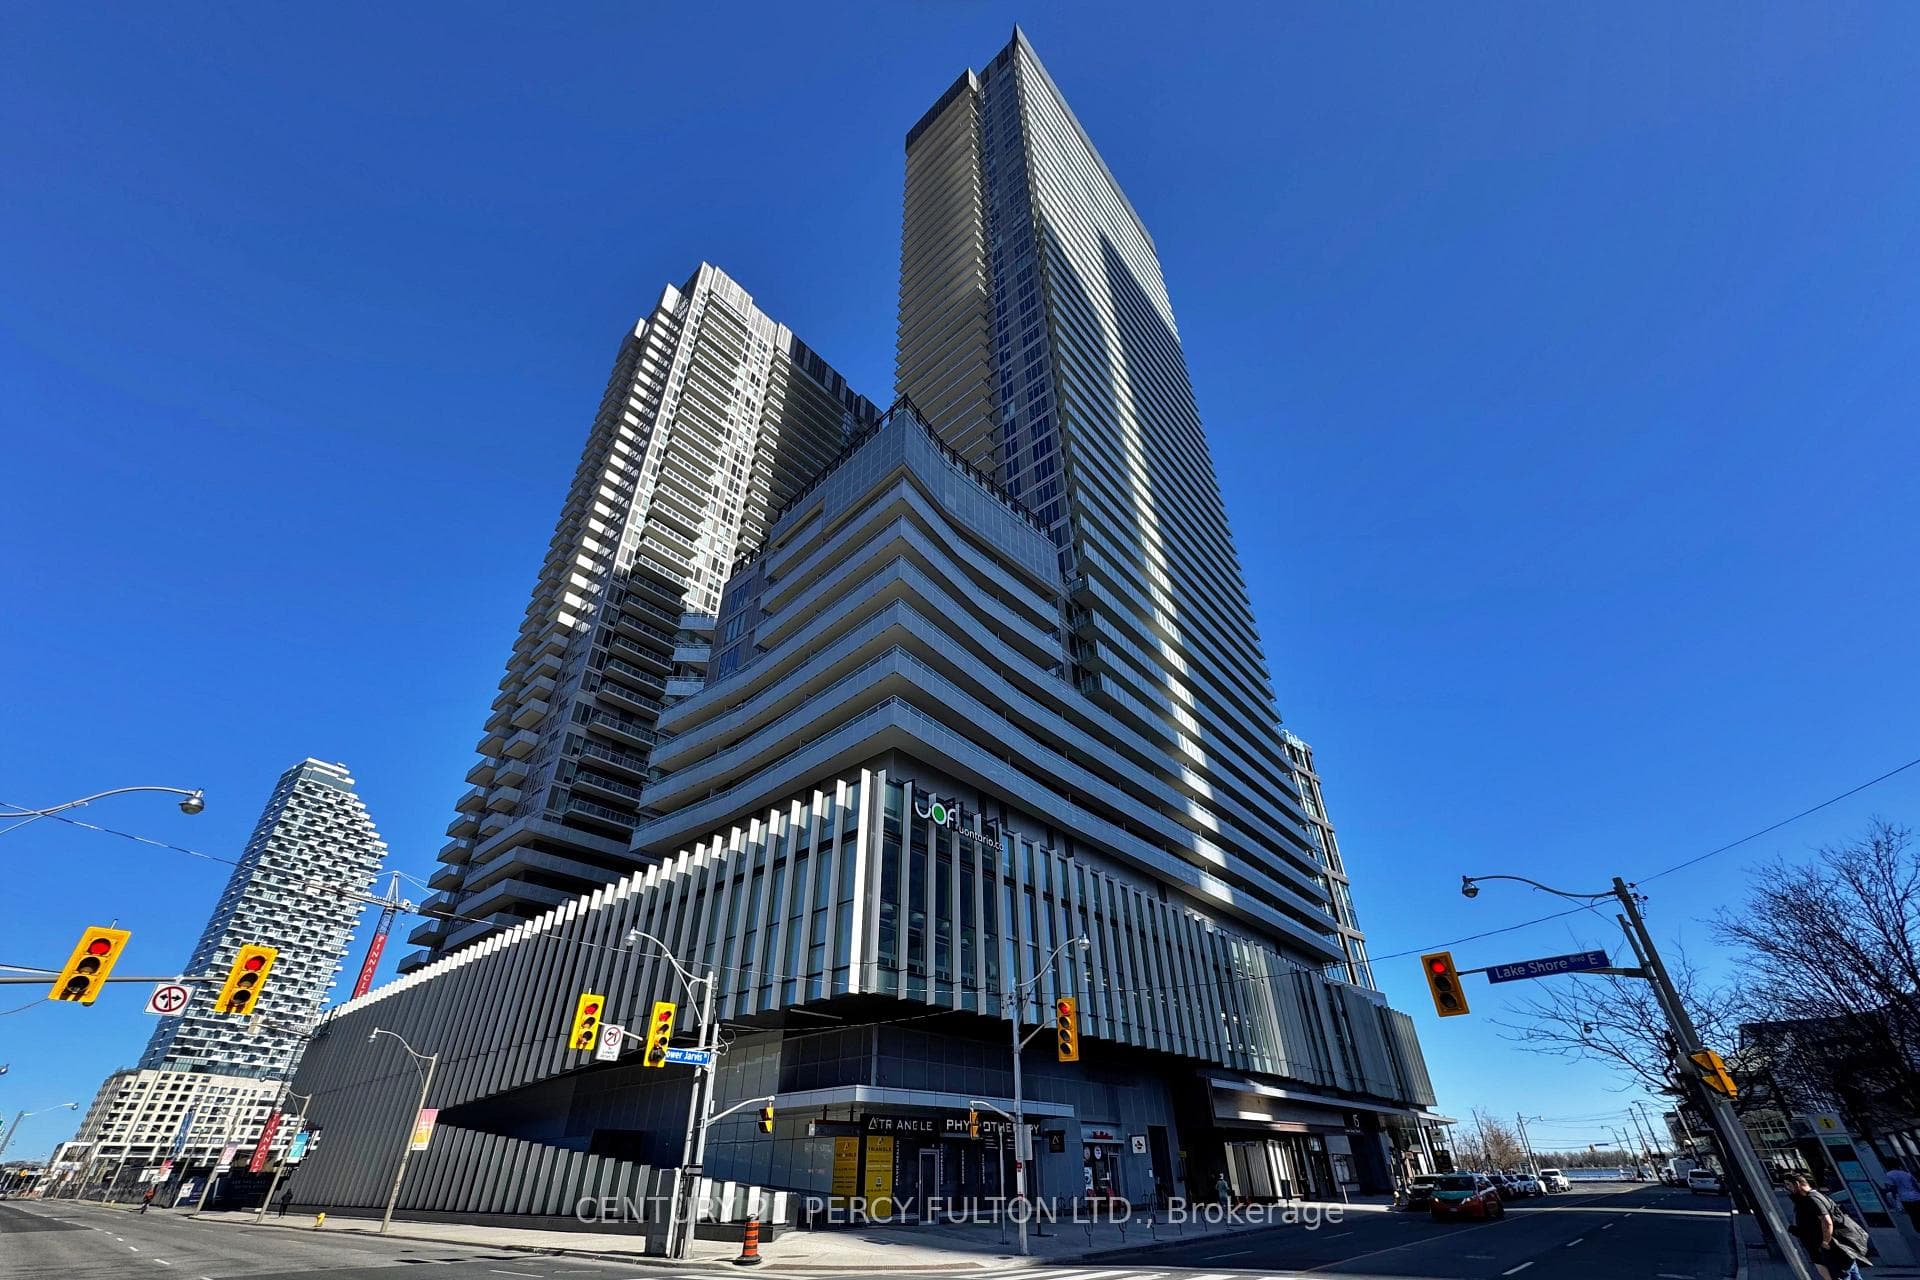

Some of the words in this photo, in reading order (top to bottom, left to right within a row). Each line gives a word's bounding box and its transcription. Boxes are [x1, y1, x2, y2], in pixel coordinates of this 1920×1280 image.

[1495, 965, 1526, 980] Lake
[1528, 958, 1568, 974] Shore
[1587, 953, 1599, 966] E
[665, 1052, 682, 1060] ower
[683, 1052, 704, 1061] Jarvis
[879, 1119, 933, 1131] TRANGLE
